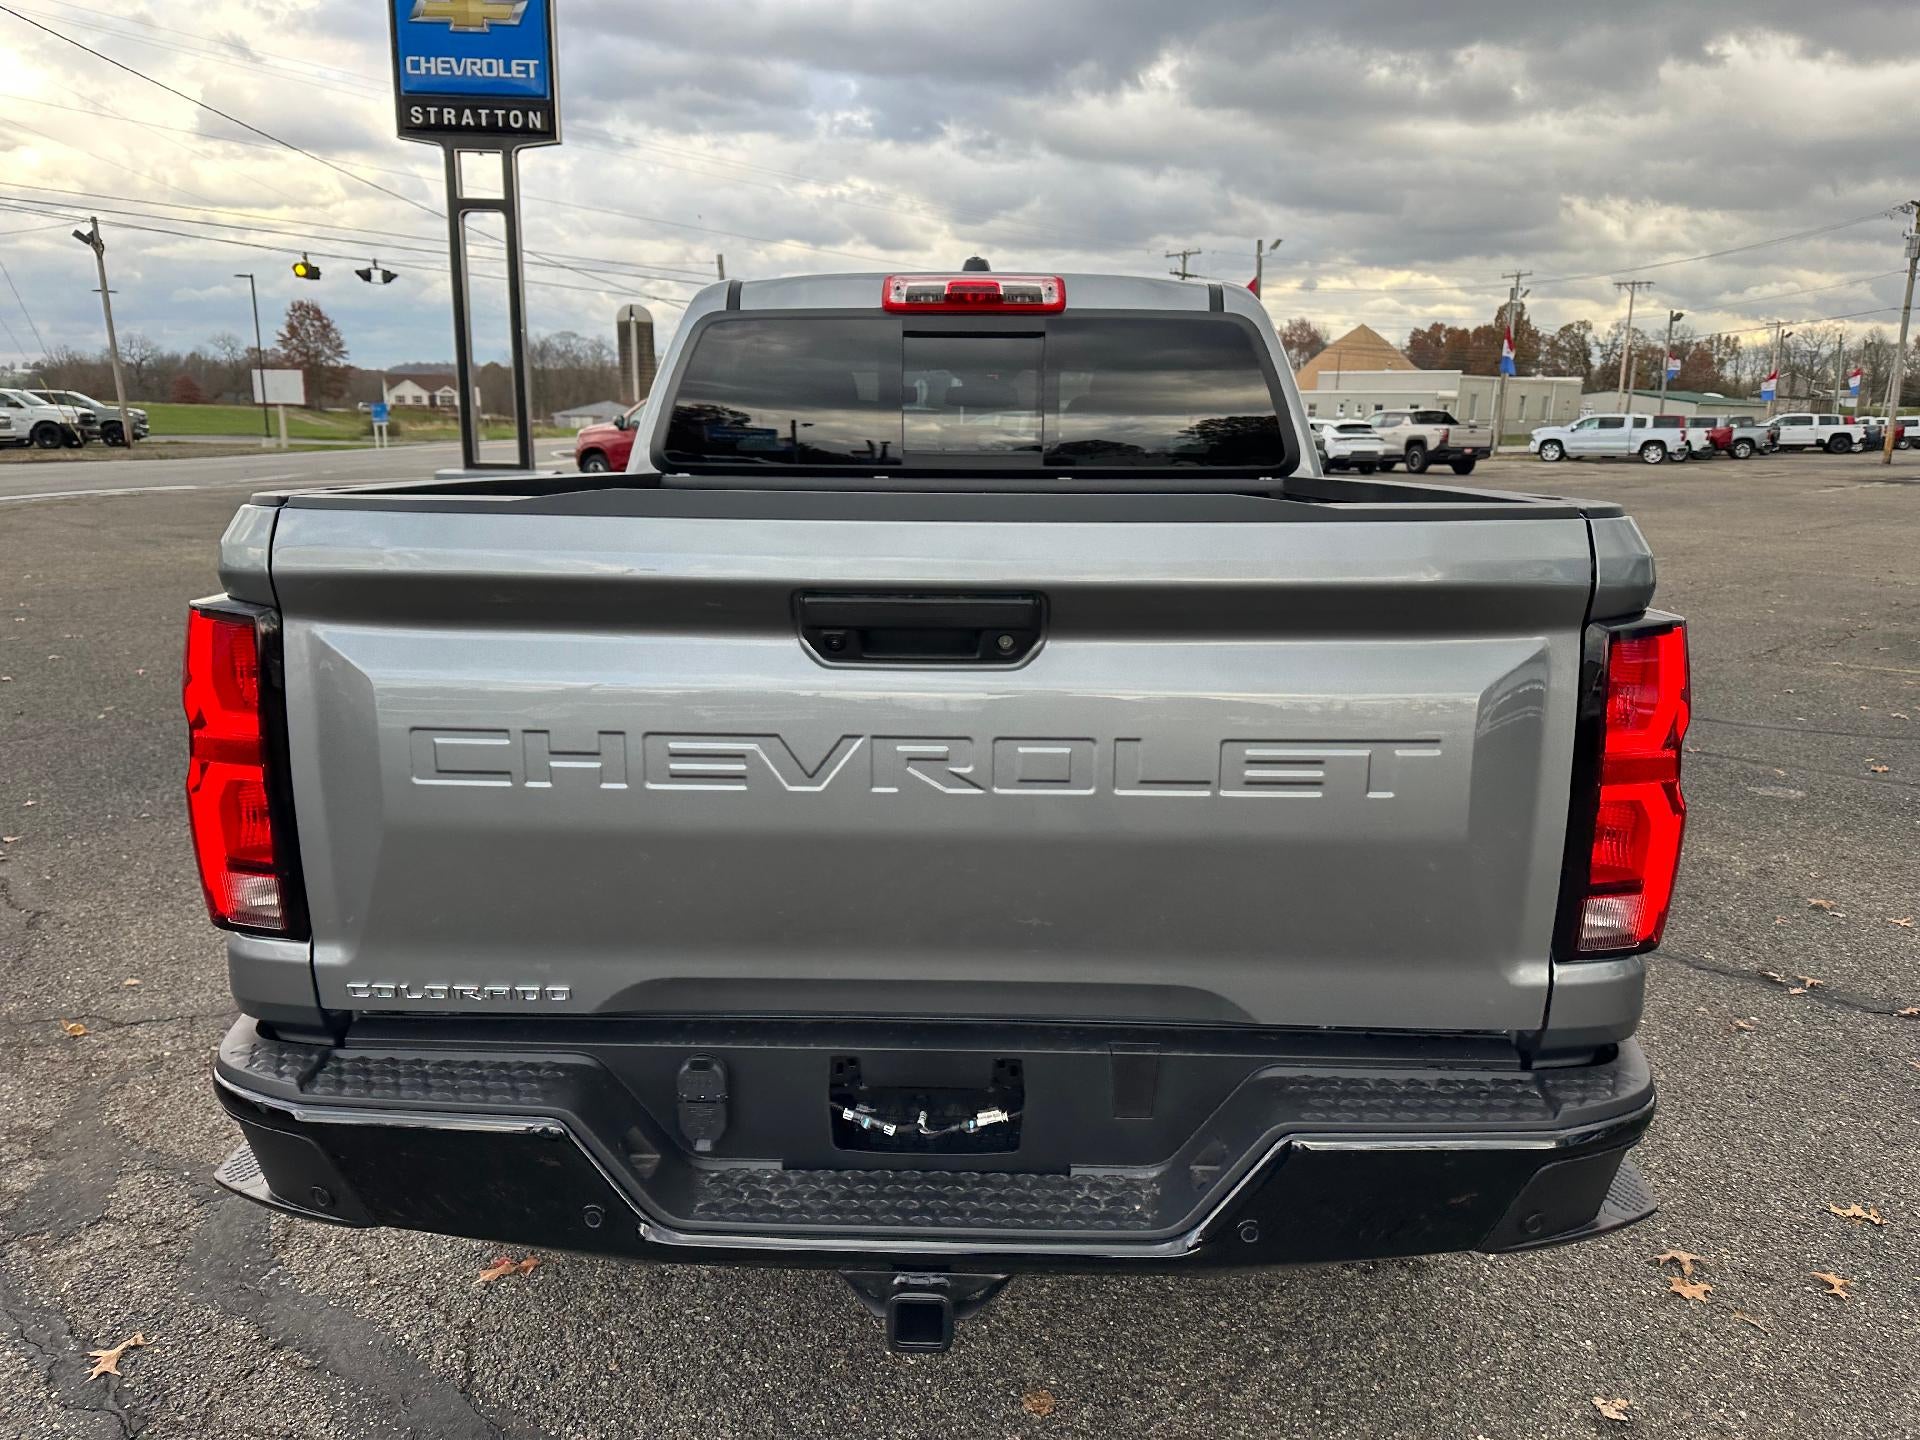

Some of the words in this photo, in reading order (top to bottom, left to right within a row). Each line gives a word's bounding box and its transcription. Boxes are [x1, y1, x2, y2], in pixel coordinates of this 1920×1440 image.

[405, 55, 540, 79] CHEVROLET
[410, 106, 542, 129] STRATTON
[409, 727, 1443, 799] CHEVROLET
[346, 981, 572, 1001] COLORADO
